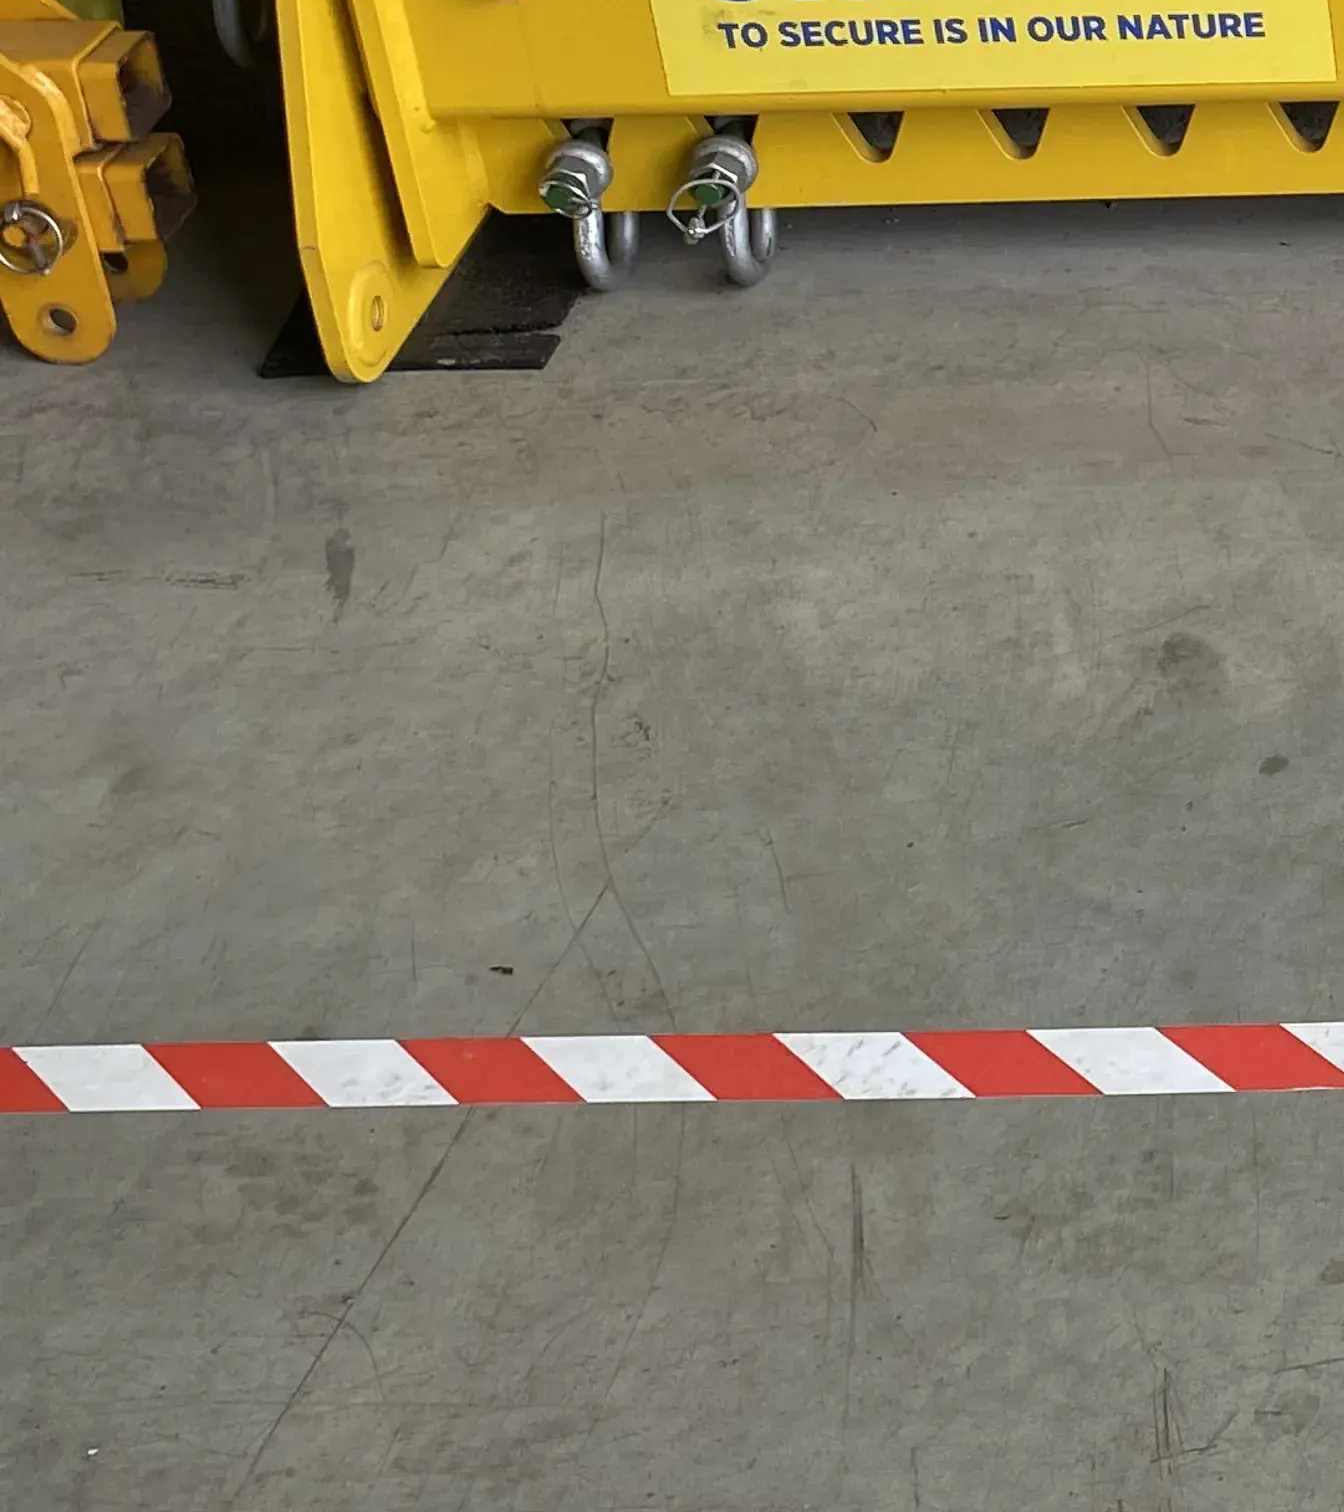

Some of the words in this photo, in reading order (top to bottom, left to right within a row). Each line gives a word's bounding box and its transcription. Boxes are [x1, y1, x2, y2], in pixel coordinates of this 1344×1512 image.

[717, 22, 769, 49] TO
[778, 19, 925, 48] SECURE
[934, 18, 968, 45] IS
[978, 17, 1017, 43] IN
[1027, 15, 1107, 42] OUR
[1117, 12, 1266, 41] NATURE
